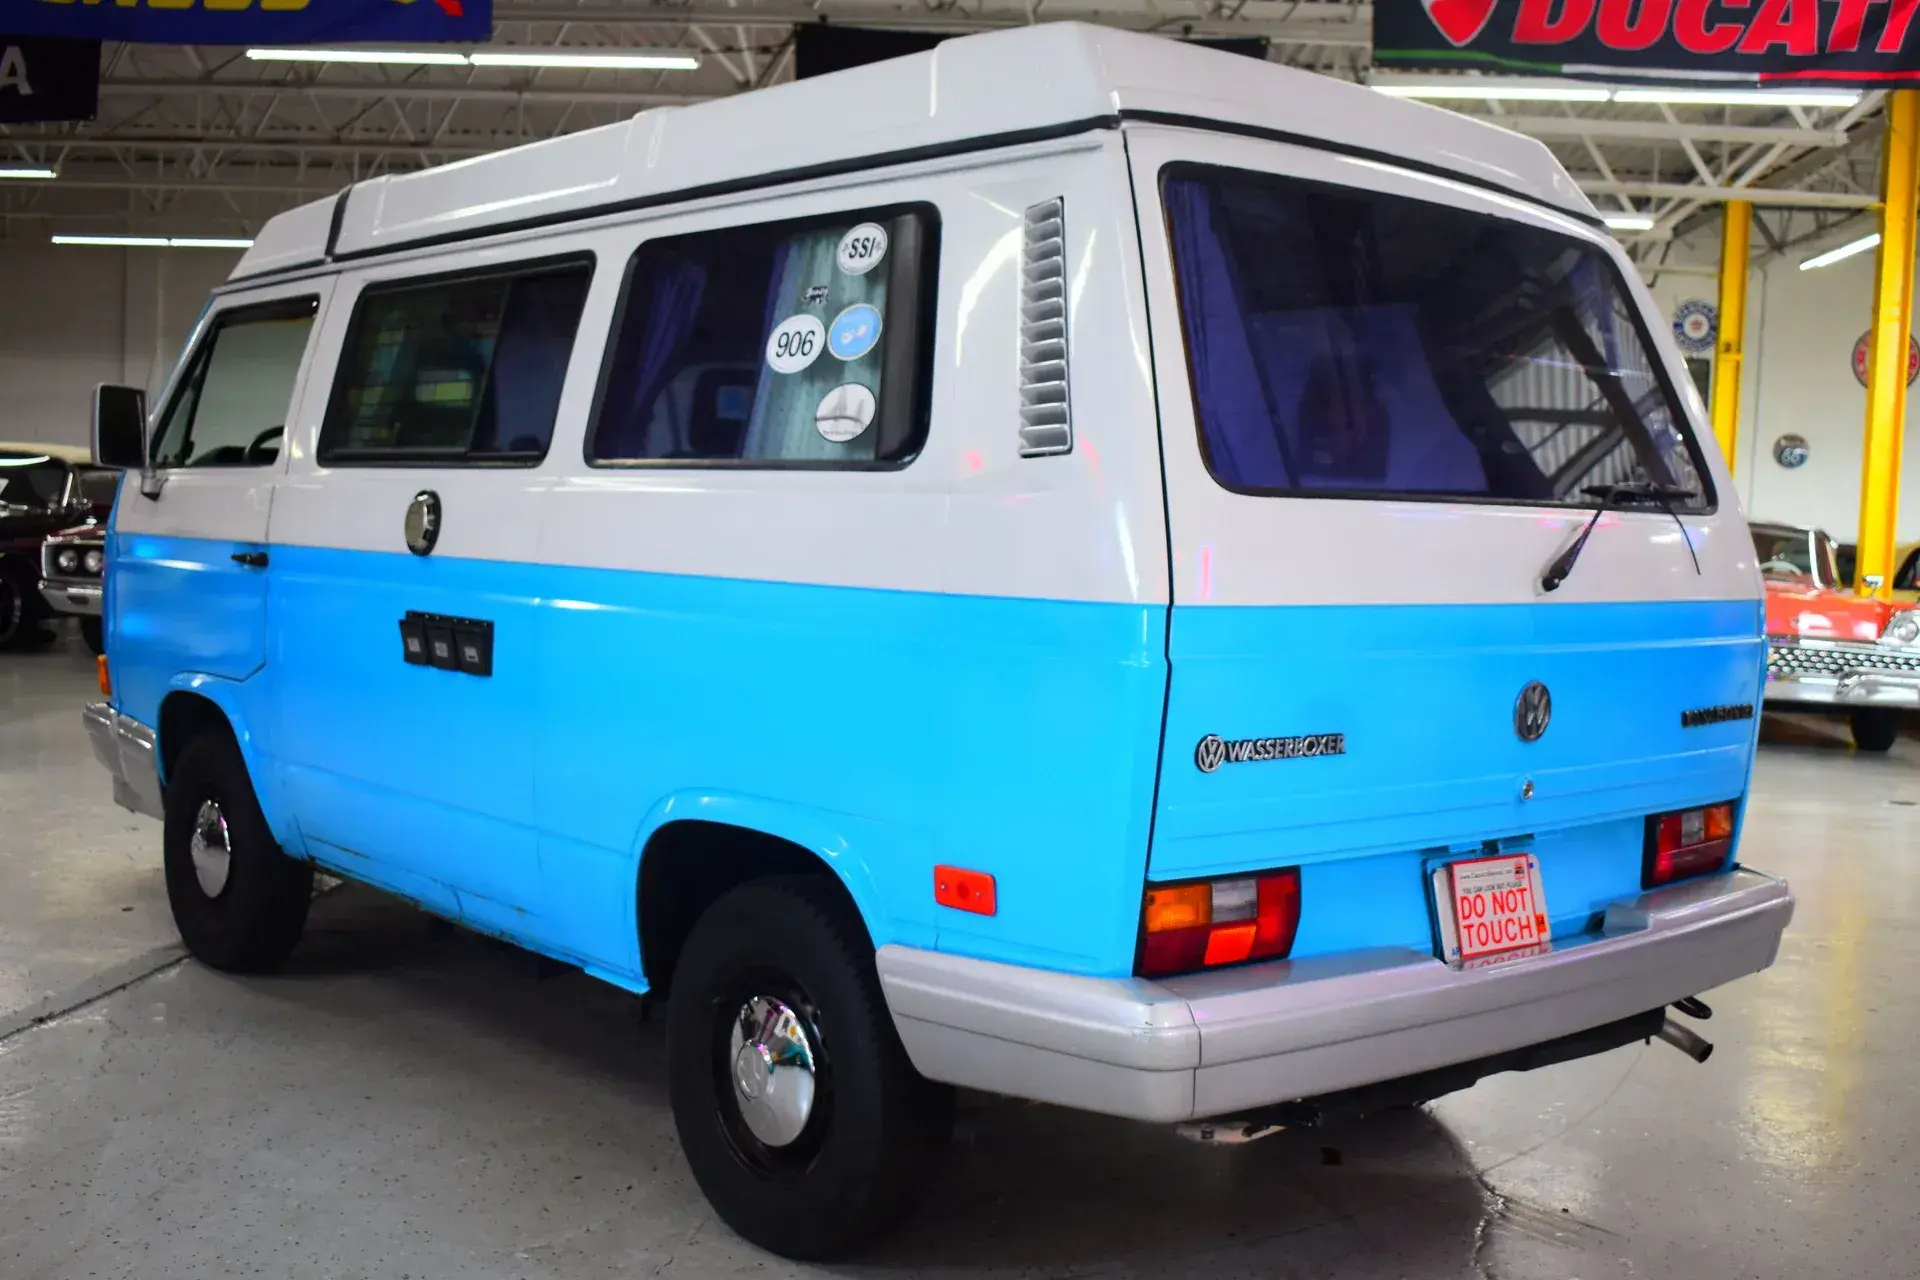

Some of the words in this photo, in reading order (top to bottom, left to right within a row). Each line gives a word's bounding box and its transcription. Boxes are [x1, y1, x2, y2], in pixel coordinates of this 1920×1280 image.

[1511, 0, 1914, 55] DUCATI
[848, 236, 876, 259] SSI
[775, 330, 816, 358] 906
[1227, 734, 1345, 762] WASSERBOXER
[1460, 893, 1486, 920] DO
[1492, 887, 1528, 916] NOT
[1462, 915, 1534, 948] TOUCH
